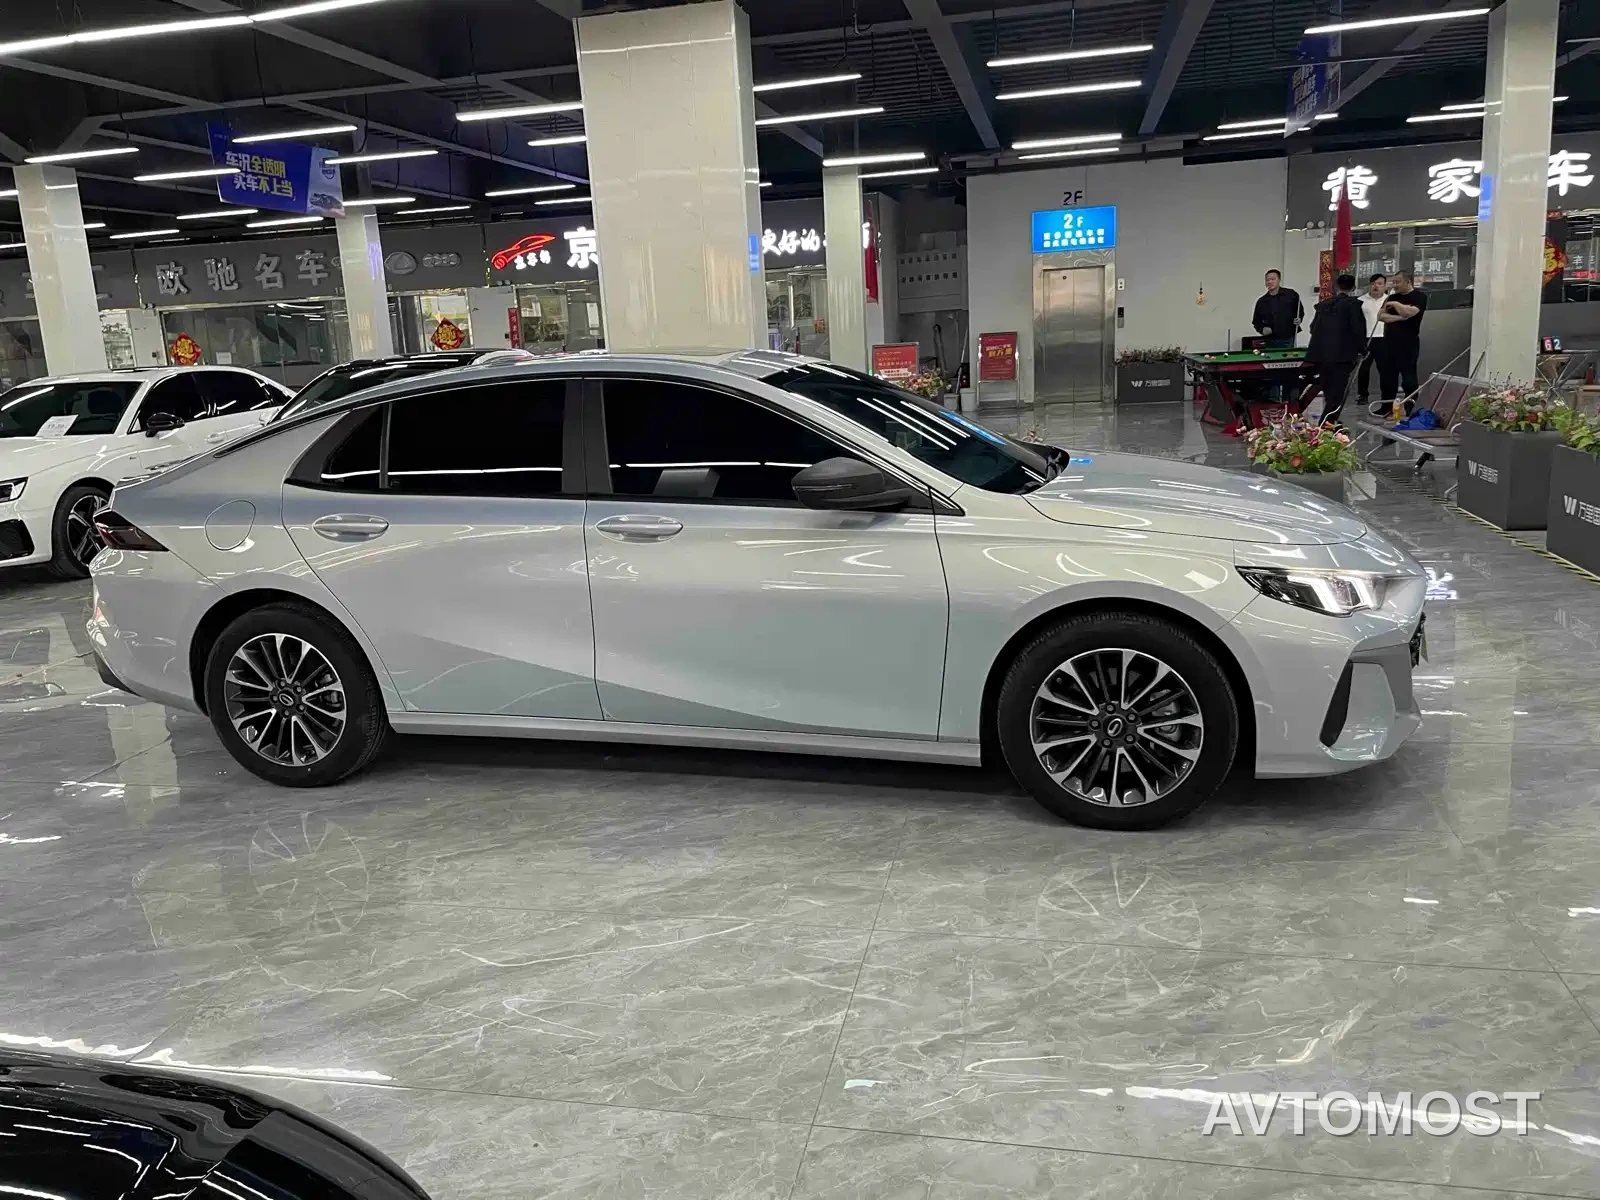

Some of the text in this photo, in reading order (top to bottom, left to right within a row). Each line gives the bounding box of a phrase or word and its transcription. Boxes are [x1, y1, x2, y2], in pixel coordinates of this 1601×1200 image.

[225, 151, 286, 178] 车况全透明
[233, 173, 294, 198] 买车不上当
[1063, 190, 1083, 206] 2F
[761, 228, 827, 256] 更好的
[155, 249, 329, 297] 欧驰名车
